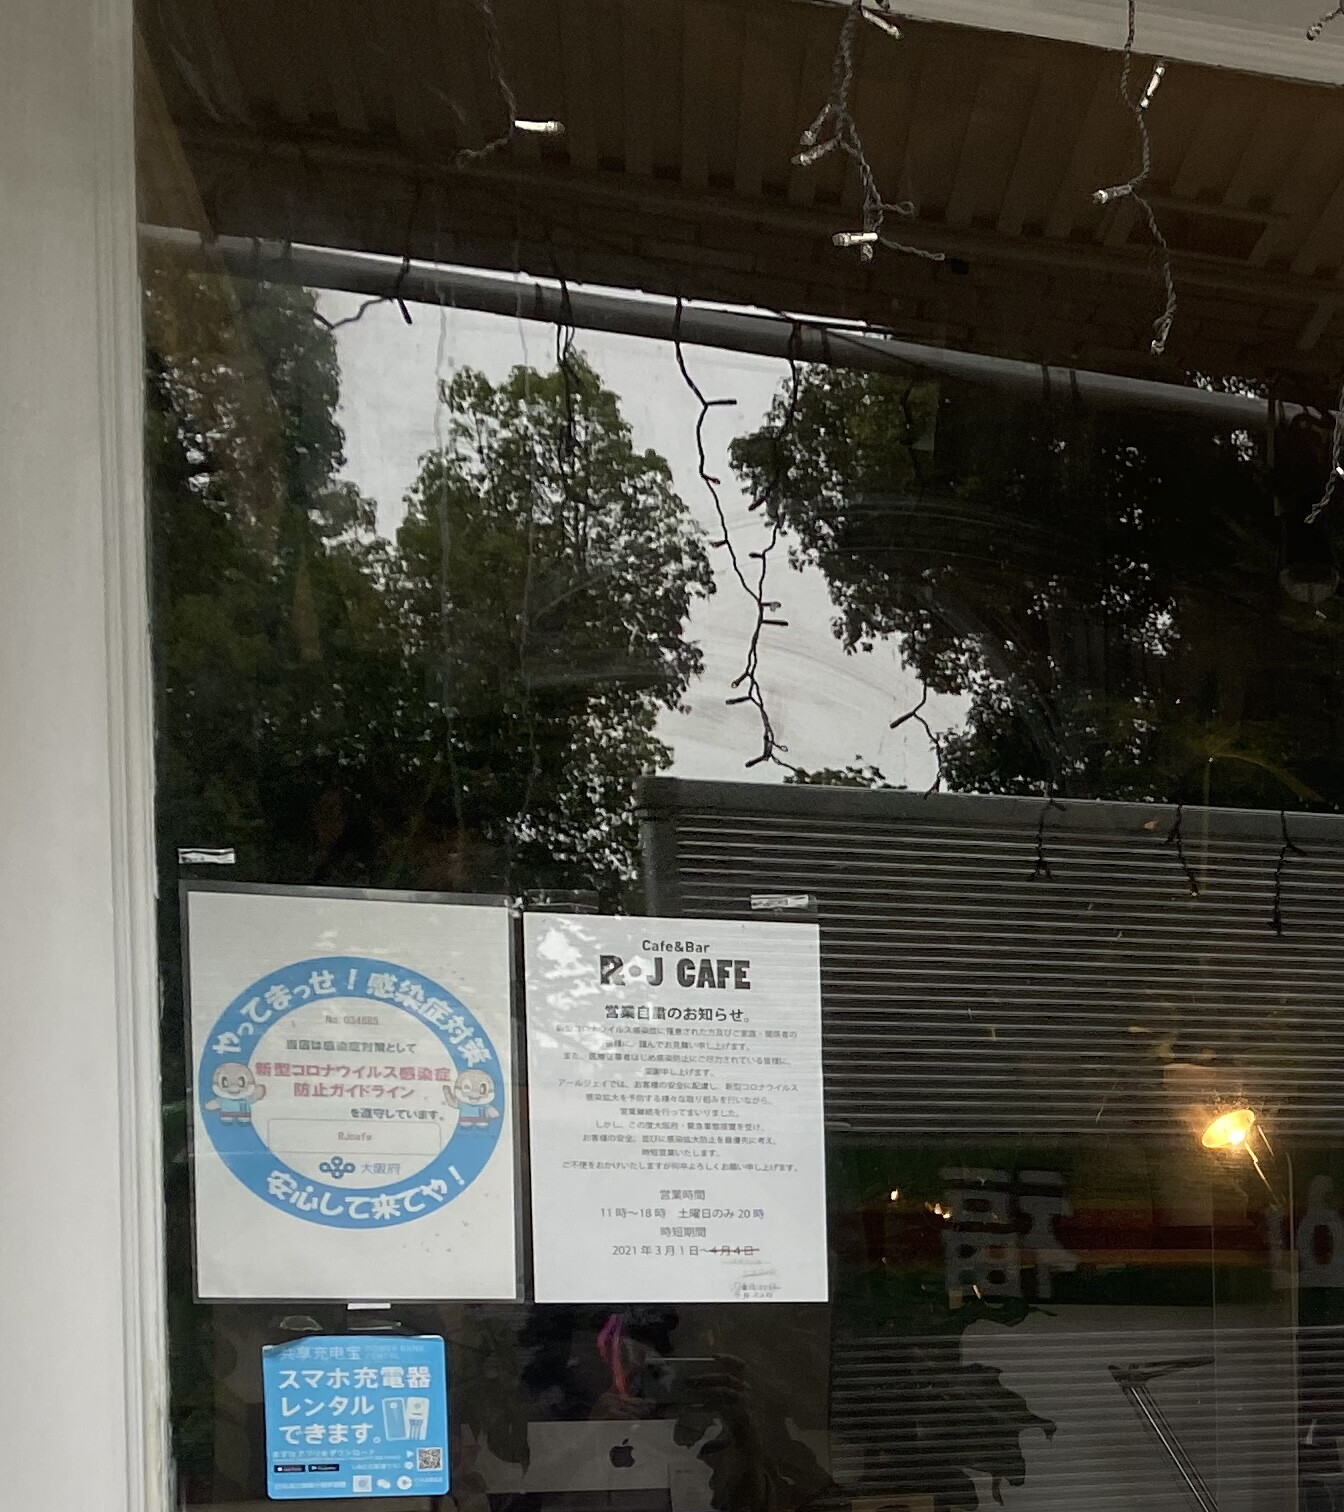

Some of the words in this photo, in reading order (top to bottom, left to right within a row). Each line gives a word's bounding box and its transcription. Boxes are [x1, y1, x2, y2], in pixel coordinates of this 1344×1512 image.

[642, 939, 710, 953] Cafe&Bar
[677, 959, 751, 990] CAFE
[255, 1061, 450, 1082] 新型コロナウイルス感染症
[293, 1083, 416, 1099] 防止ガイドライン
[660, 1189, 706, 1201] 営業時間
[279, 1366, 431, 1389] スマホ充電器
[281, 1395, 375, 1417] レンタル
[279, 1423, 381, 1444] できます。
